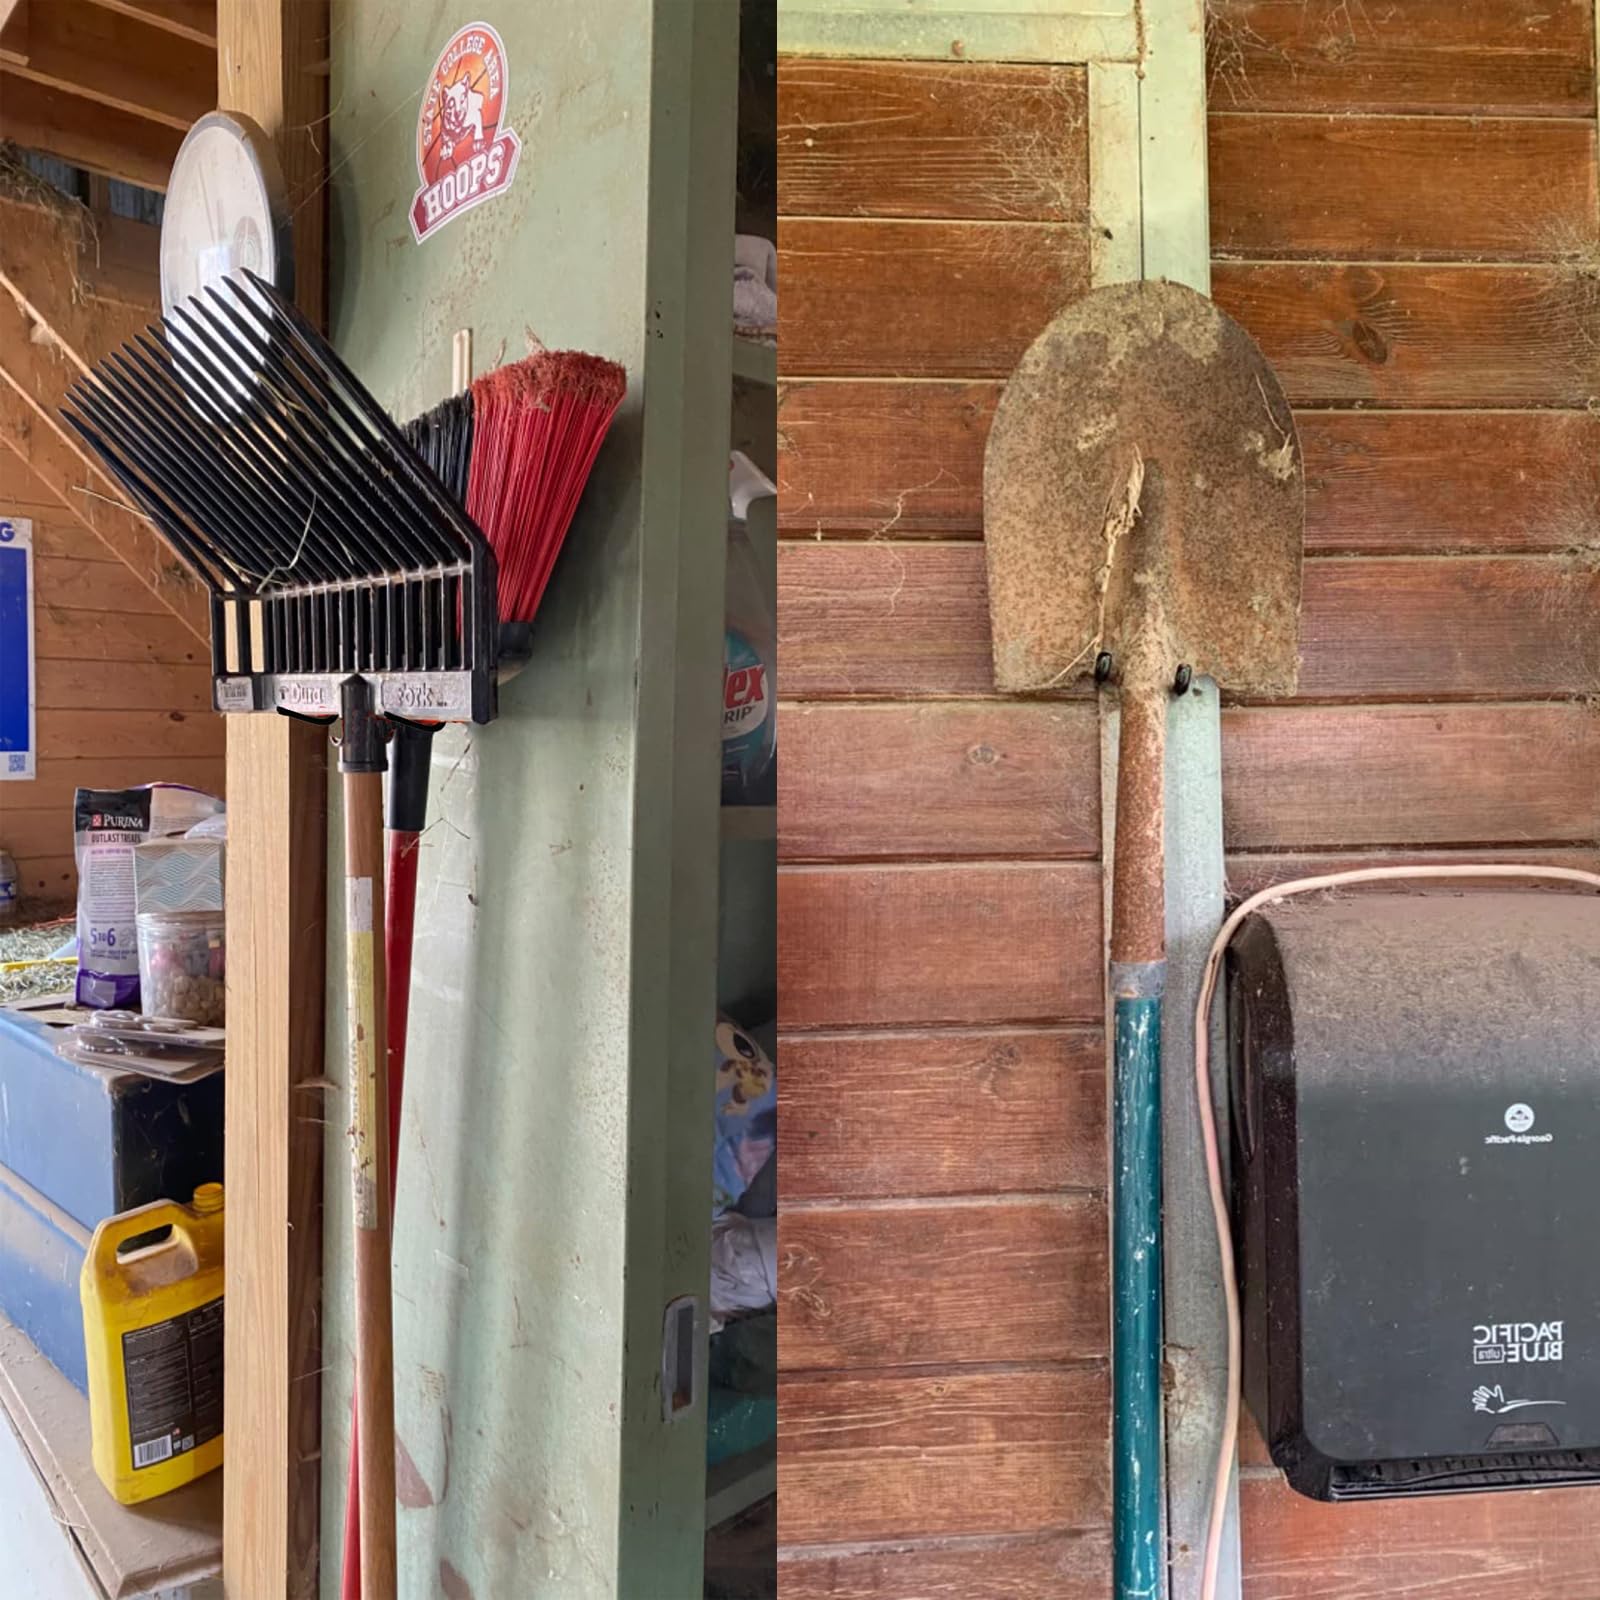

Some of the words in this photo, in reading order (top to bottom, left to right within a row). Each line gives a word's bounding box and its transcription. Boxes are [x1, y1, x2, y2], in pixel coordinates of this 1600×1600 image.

[423, 79, 441, 146] STATE
[442, 35, 486, 75] COLLEGE
[483, 48, 501, 100] AREA
[422, 144, 504, 224] HOOPS
[723, 665, 765, 709] ex
[724, 705, 753, 724] RIP
[103, 813, 143, 829] PURINA
[91, 833, 120, 843] OUTLAST
[90, 927, 98, 945] 5
[107, 927, 117, 946] 6
